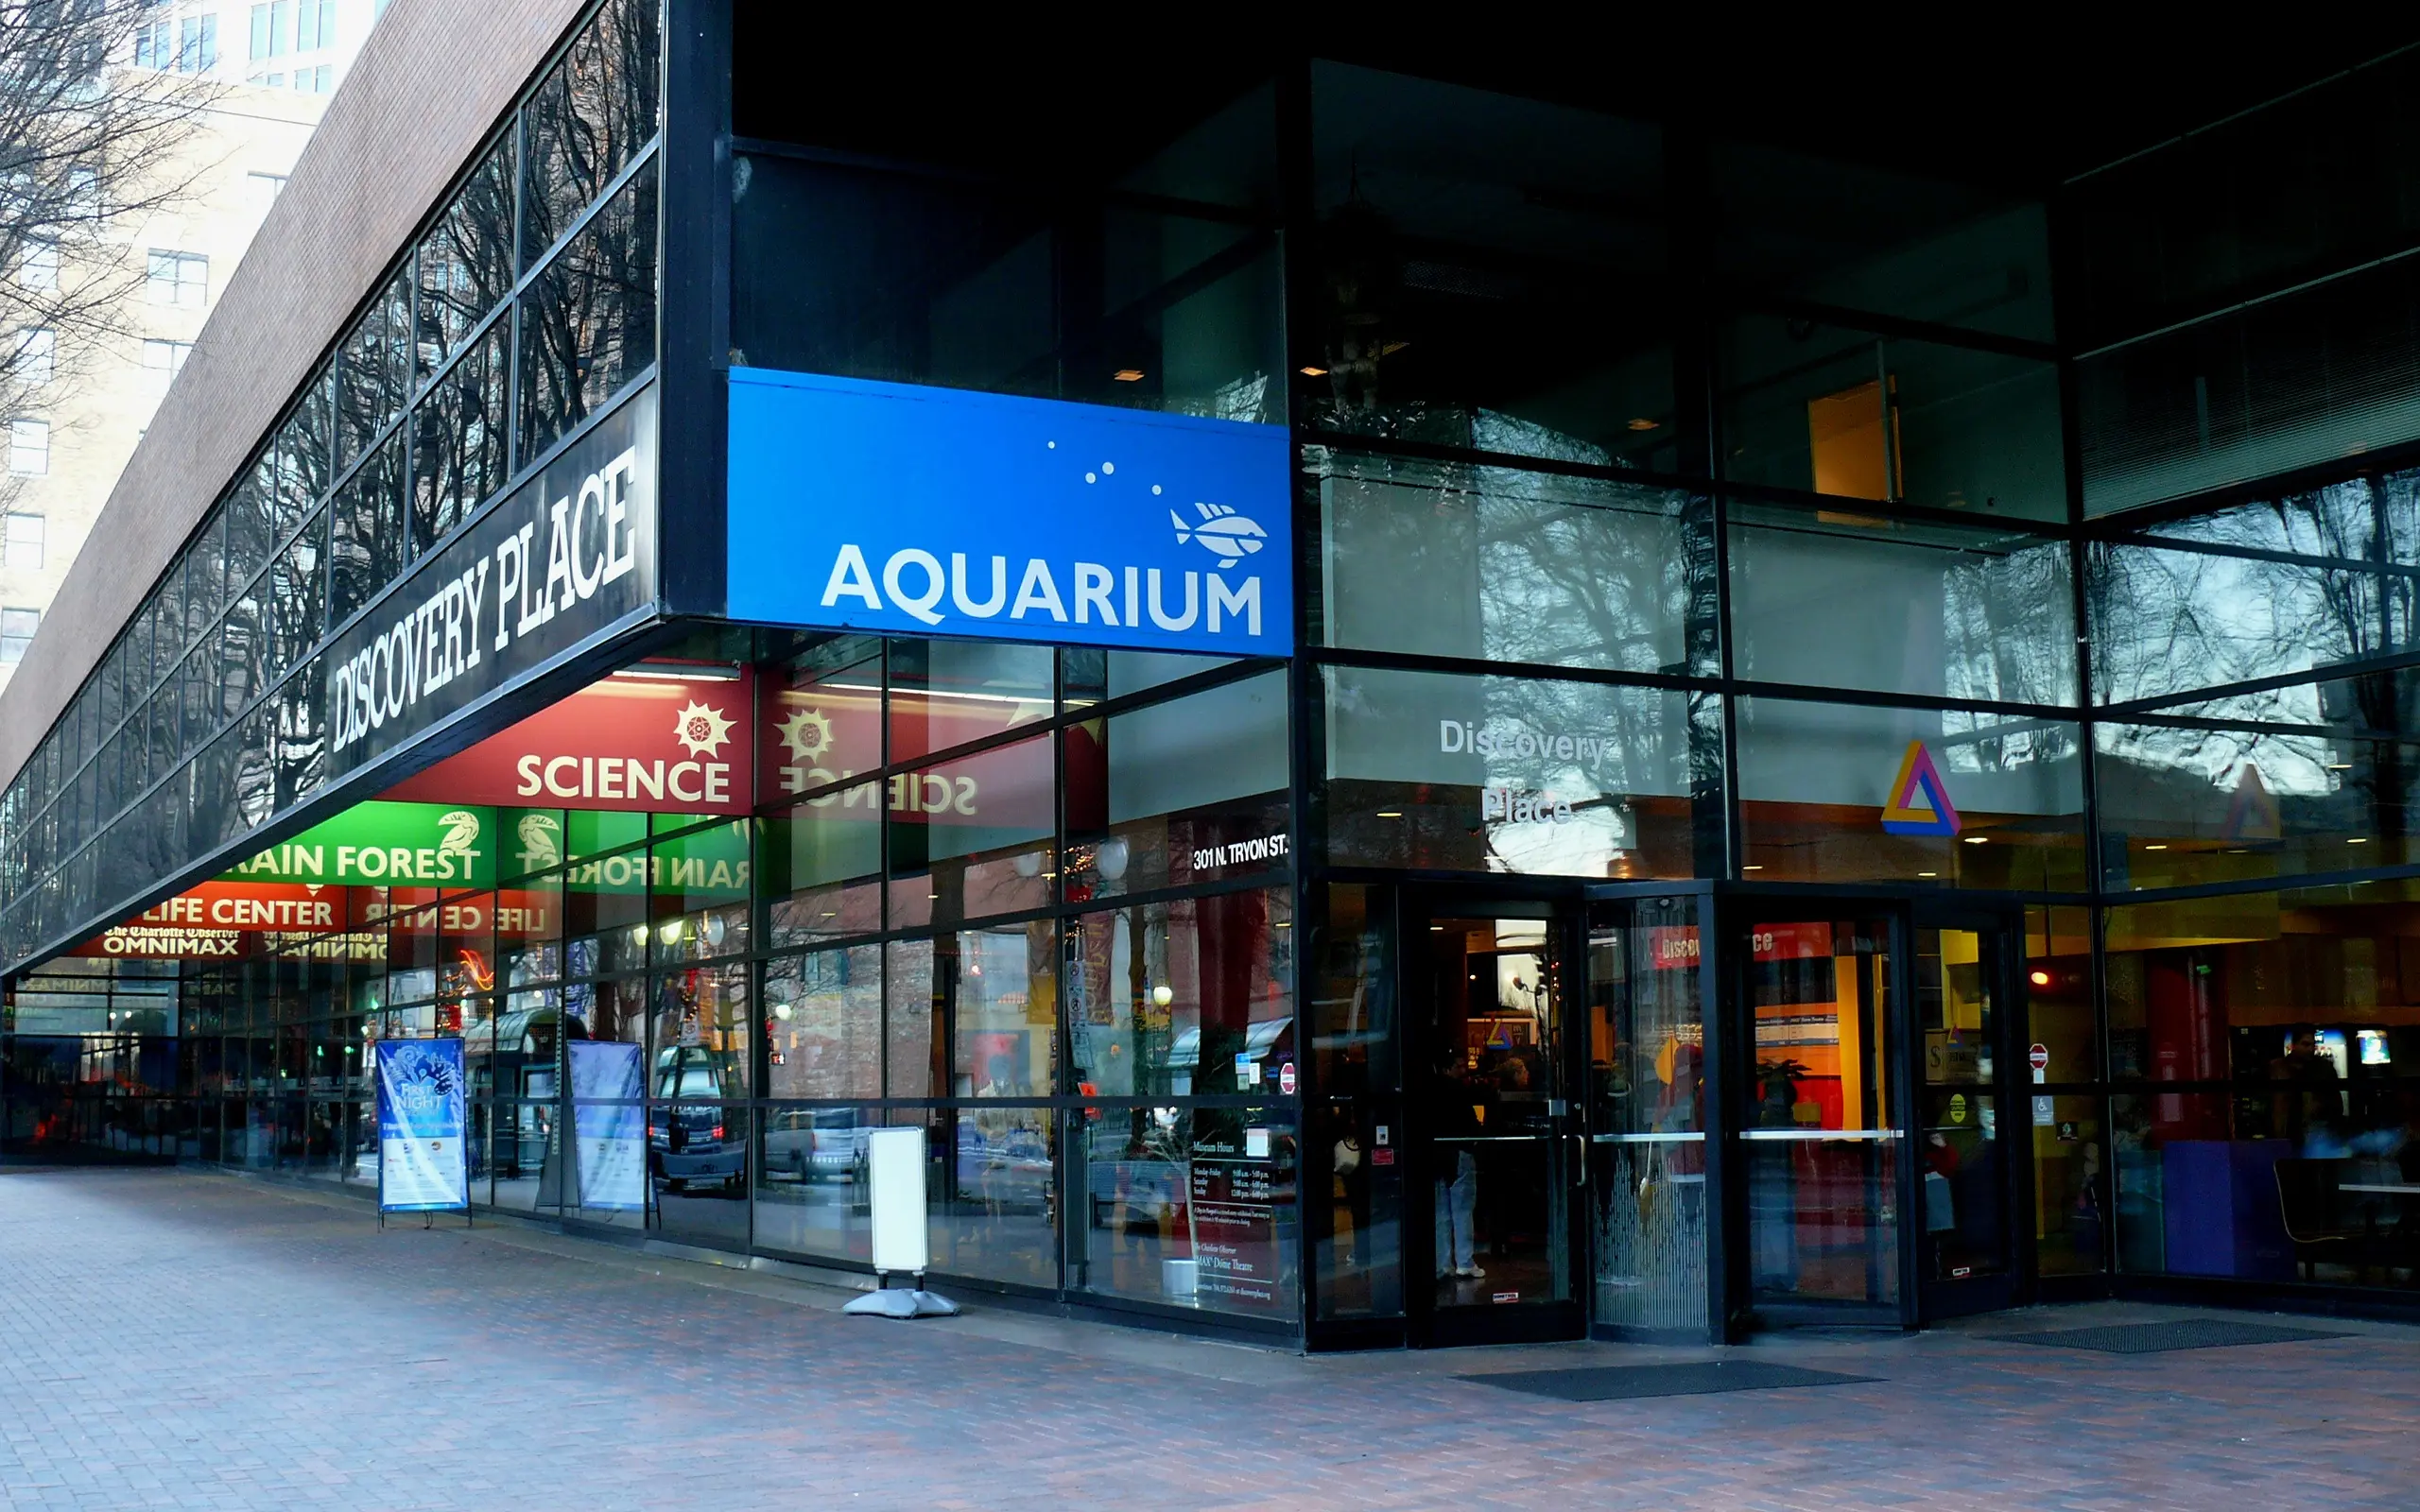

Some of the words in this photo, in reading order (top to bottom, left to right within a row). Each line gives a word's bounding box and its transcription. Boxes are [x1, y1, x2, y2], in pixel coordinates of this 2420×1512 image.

[334, 556, 489, 752] DISCOVERY
[495, 445, 635, 652] PLACE
[821, 544, 1261, 636] AQUARIUM
[1441, 720, 1606, 771] Discovery
[517, 755, 730, 802] SCIENCE
[1481, 788, 1572, 824] Place
[337, 846, 480, 879] FOREST
[1193, 849, 1213, 869] 301
[1215, 847, 1227, 866] N.
[1228, 838, 1268, 864] TRYON
[1269, 833, 1288, 857] ST.
[142, 898, 203, 922] LIFE
[212, 900, 333, 926] CENTER
[103, 936, 238, 955] OMNIMAX
[130, 926, 184, 937] Charlotte
[186, 928, 240, 938] Observer
[394, 1096, 441, 1109] NIGHT
